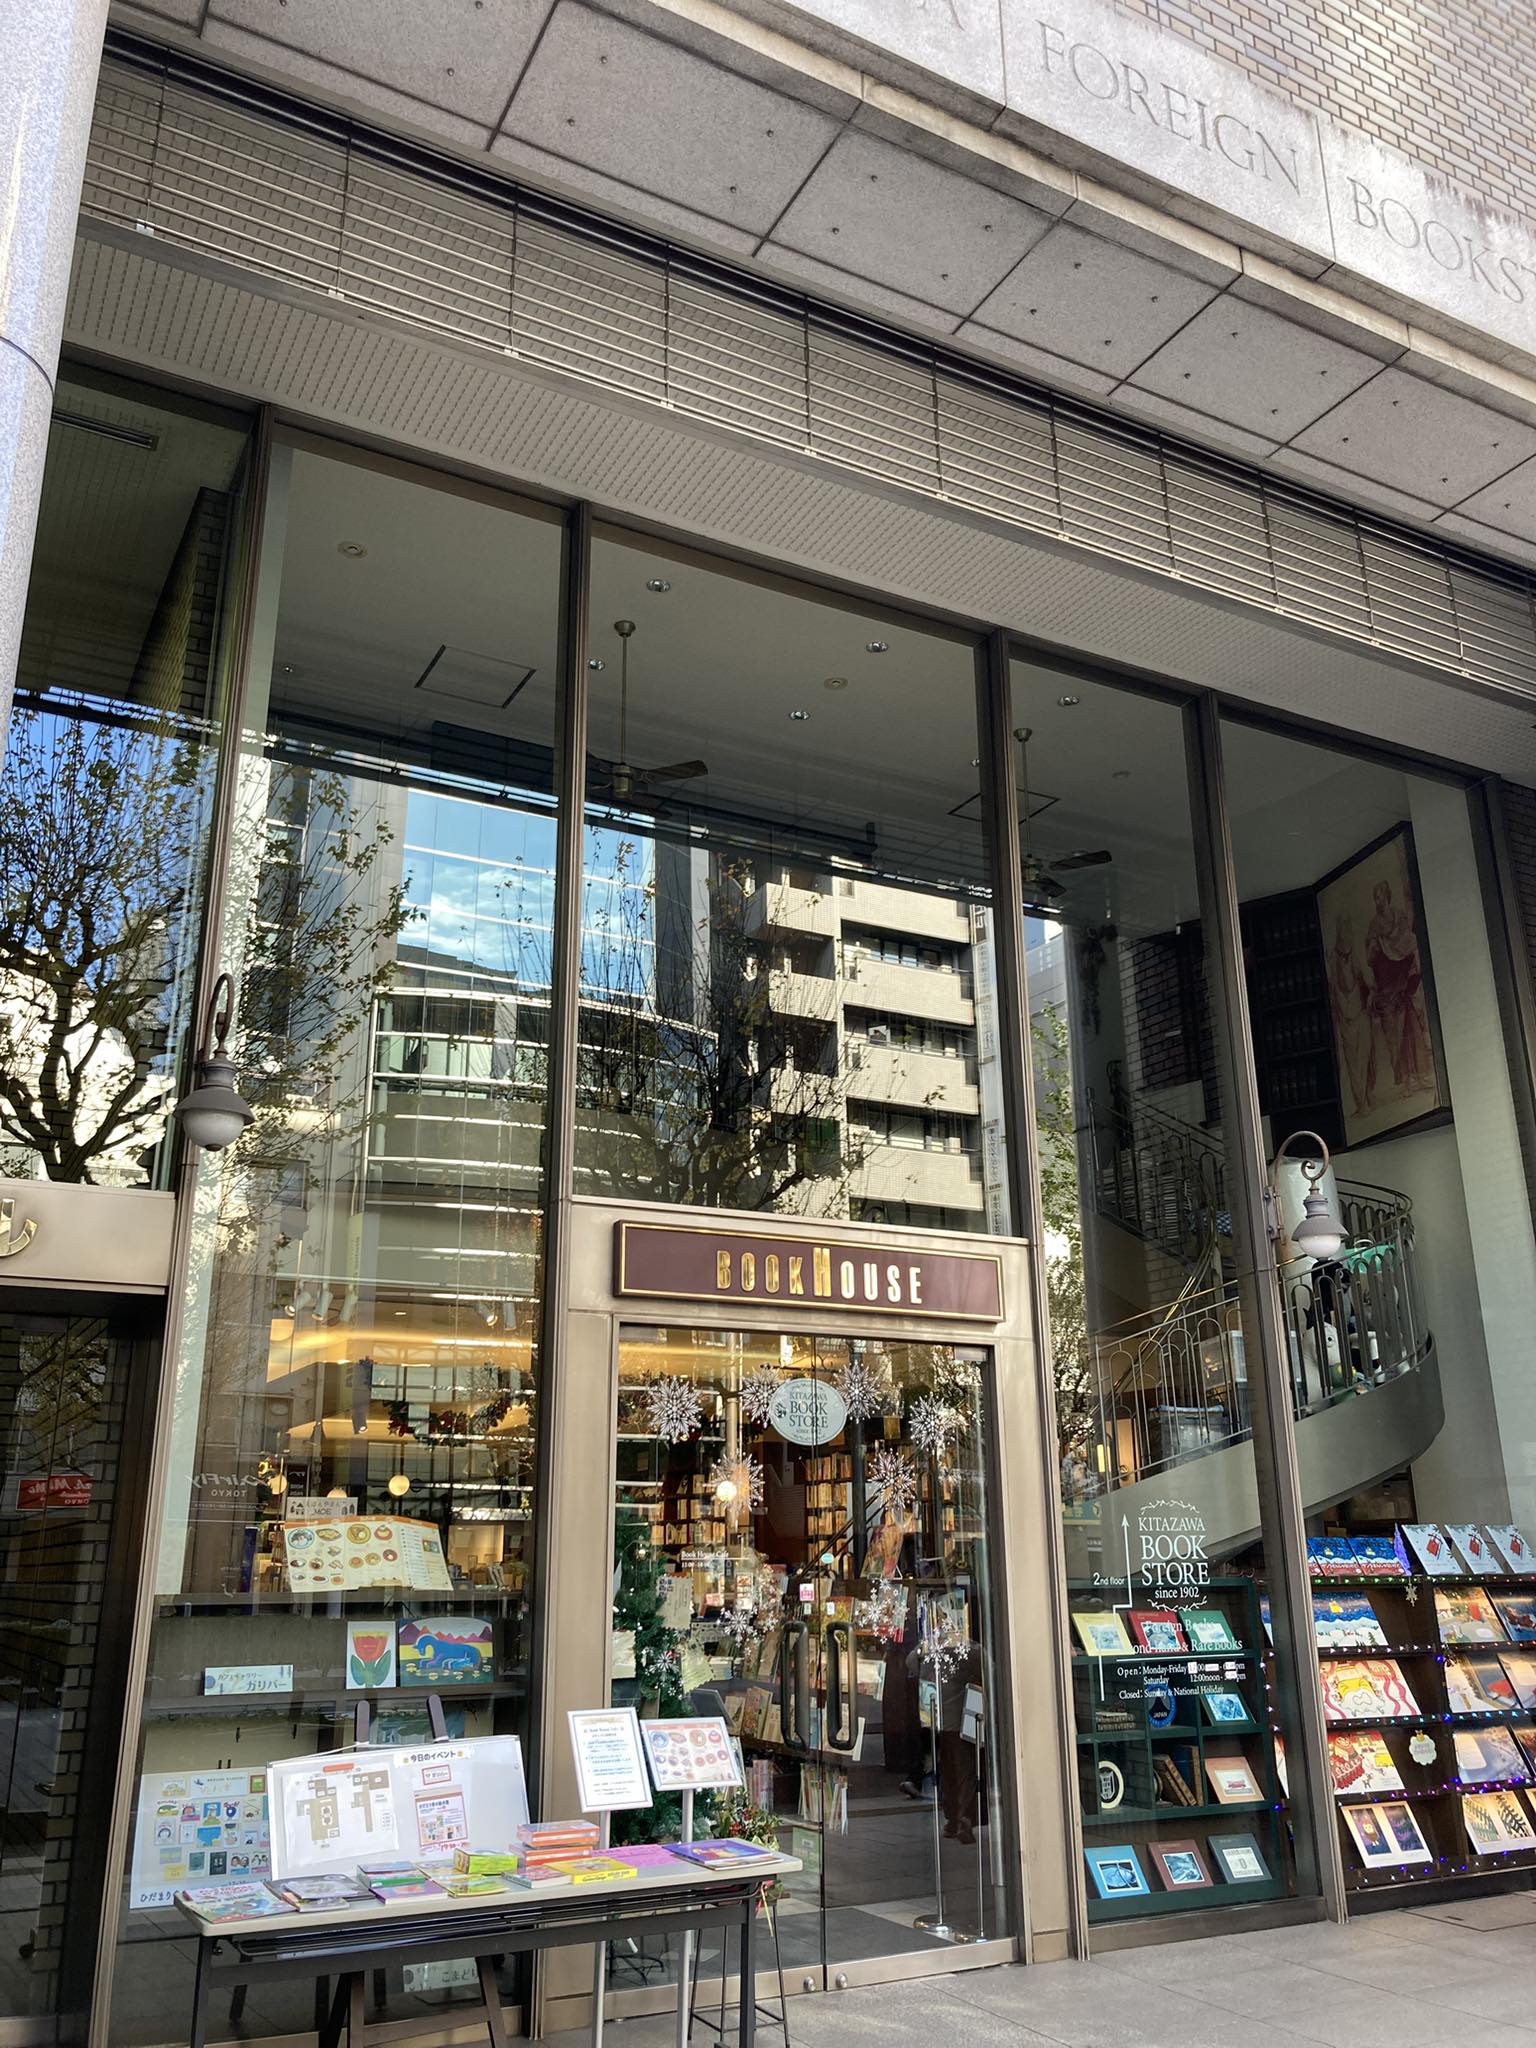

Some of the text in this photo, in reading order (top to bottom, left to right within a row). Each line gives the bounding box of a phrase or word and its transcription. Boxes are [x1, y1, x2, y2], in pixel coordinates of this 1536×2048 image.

[1036, 19, 1301, 196] FOREIGN
[716, 1247, 923, 1304] BOOKHOUSE
[790, 1401, 828, 1415] BOOK
[1138, 1517, 1206, 1531] KITAZAWA
[1140, 1534, 1208, 1560] BOOK
[1093, 1572, 1125, 1585] 2nd floor
[1141, 1562, 1210, 1586] STORE
[1154, 1586, 1200, 1598] since 1902
[1192, 1638, 1212, 1652] Rare
[1117, 1665, 1142, 1678] Open:
[1143, 1663, 1187, 1676] Monday-Friday
[246, 1679, 288, 1692] ガリバー
[1143, 1675, 1170, 1687] Saturday
[1118, 1690, 1143, 1700] Closed:
[1143, 1689, 1168, 1699] Sunday
[1174, 1686, 1200, 1697] National
[1200, 1684, 1225, 1695] Holiday
[410, 1750, 456, 1764] 今日のイベント
